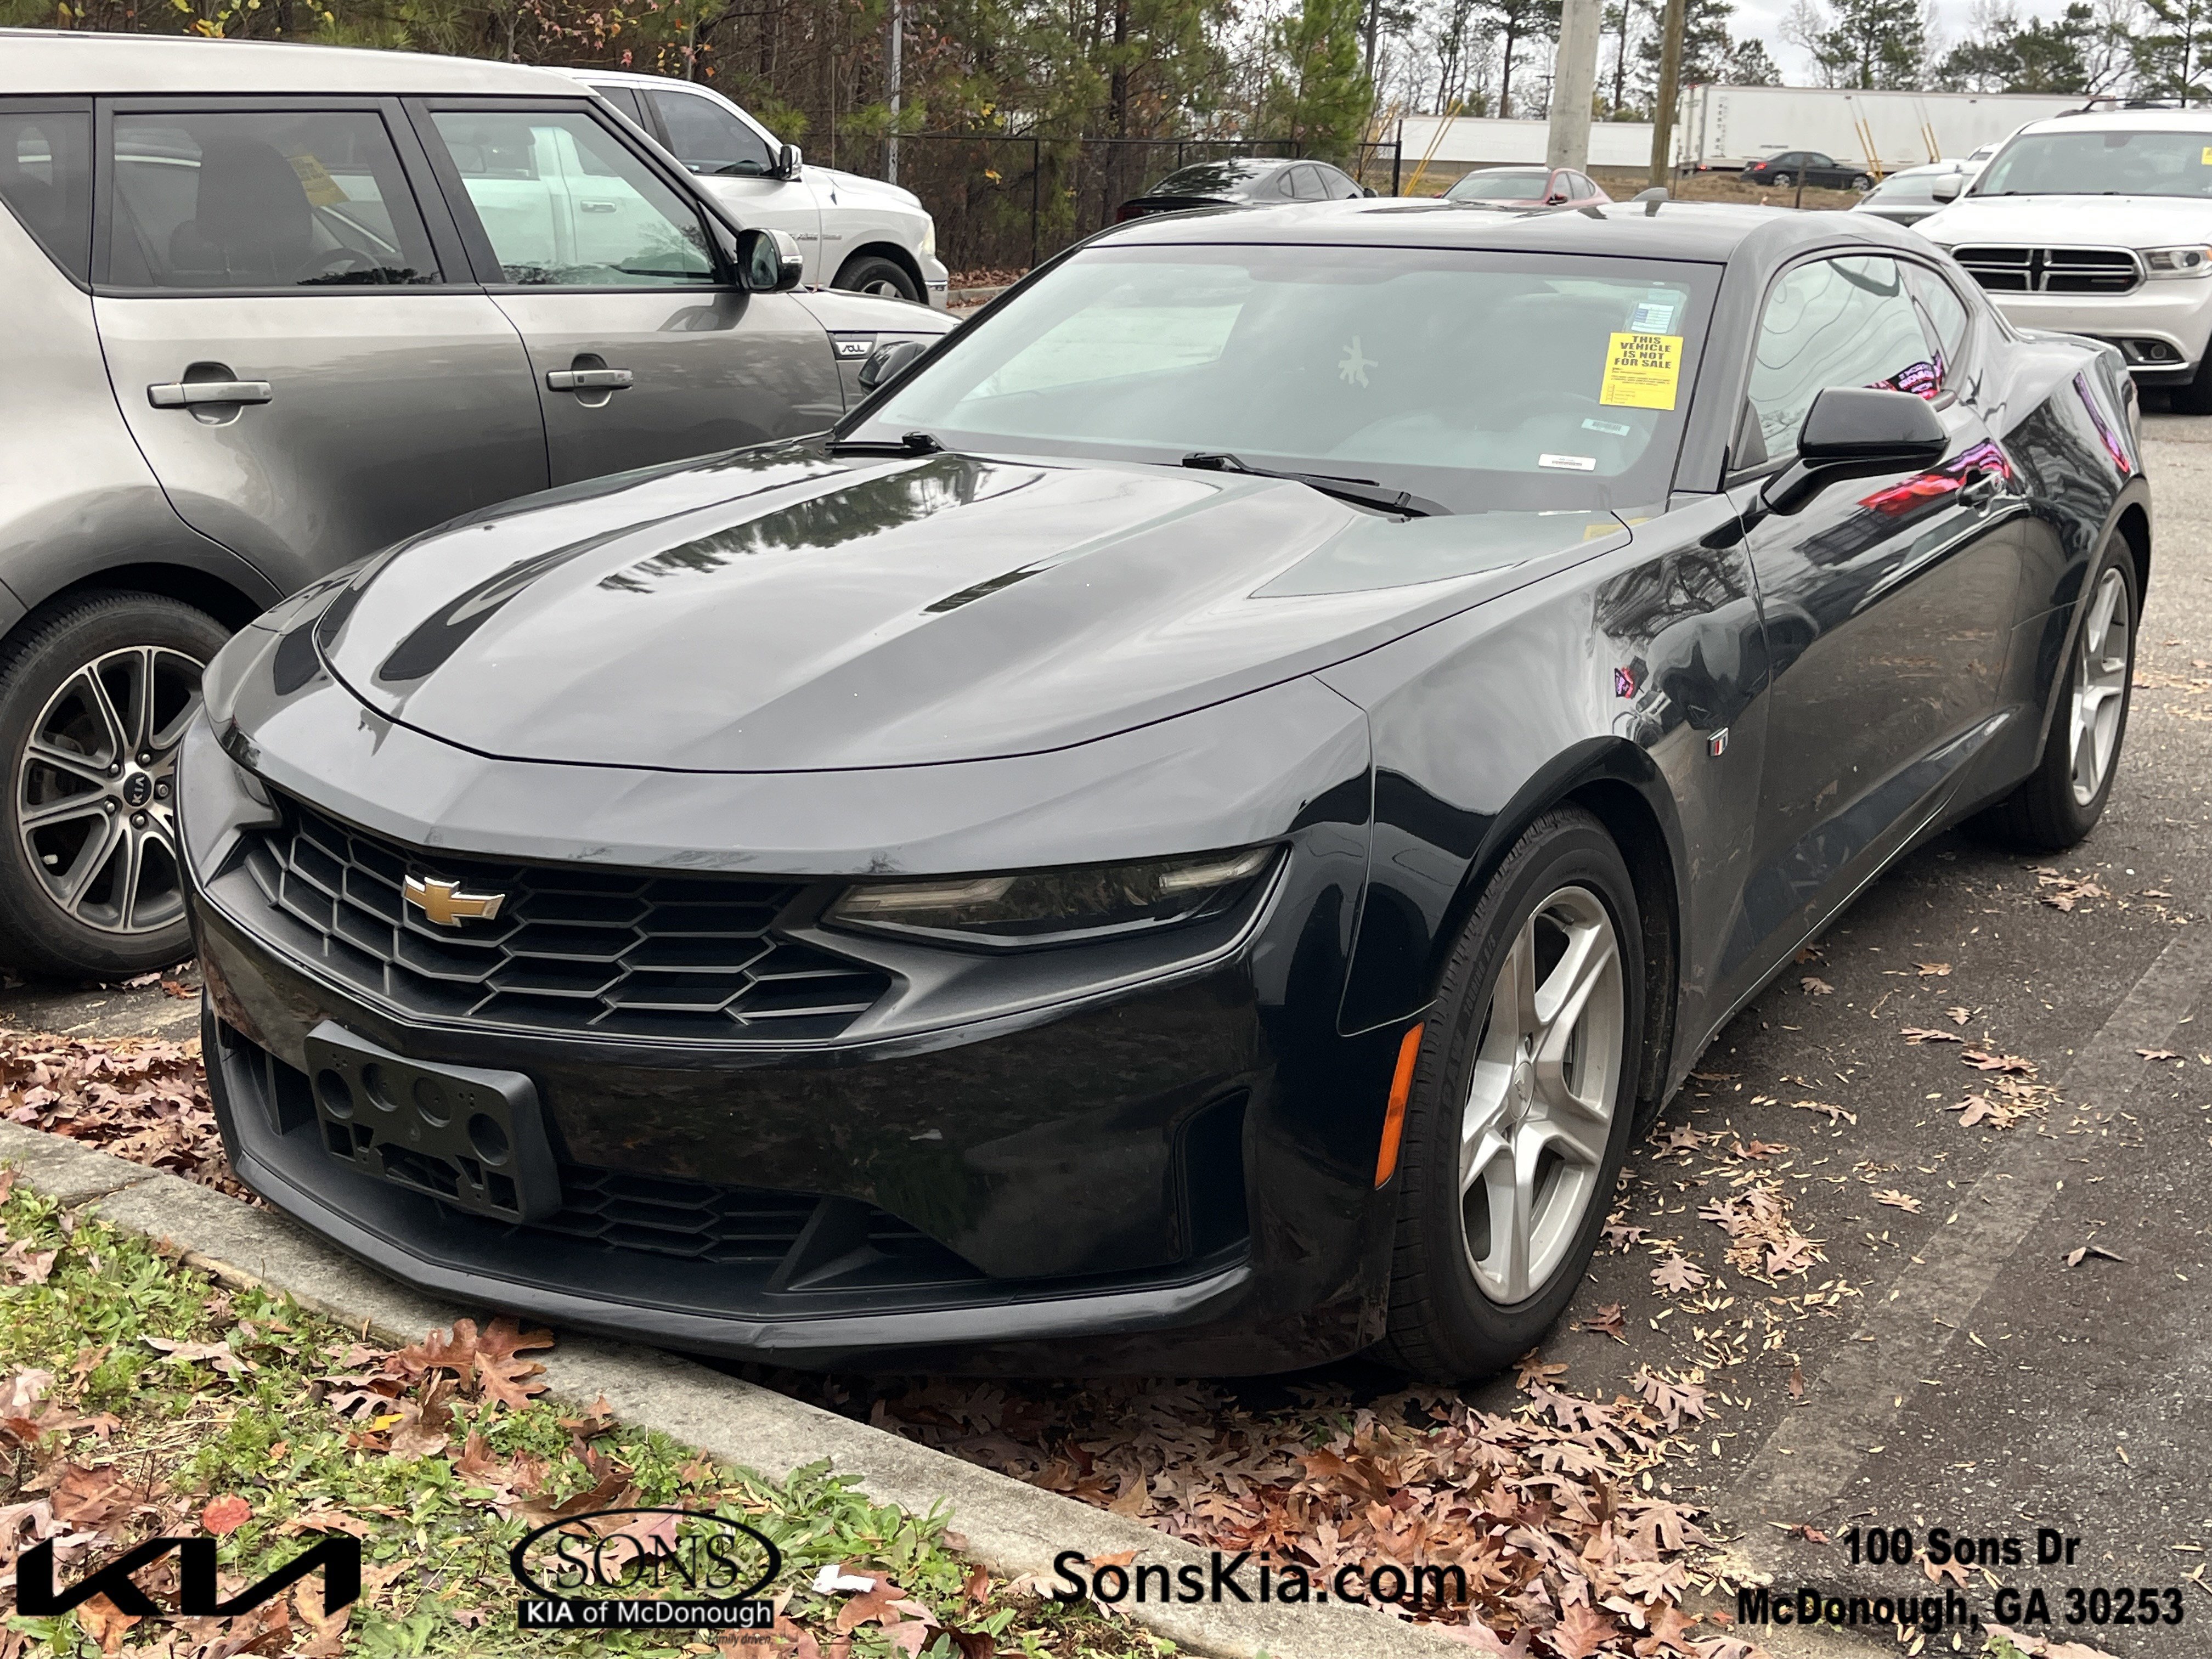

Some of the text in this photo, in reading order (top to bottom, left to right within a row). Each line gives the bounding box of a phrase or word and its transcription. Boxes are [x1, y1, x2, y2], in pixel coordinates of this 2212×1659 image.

[1632, 335, 1662, 345] THIS
[1620, 342, 1672, 353] VEHICLE
[1639, 351, 1665, 360] NOT
[1614, 358, 1672, 369] FOR SALE
